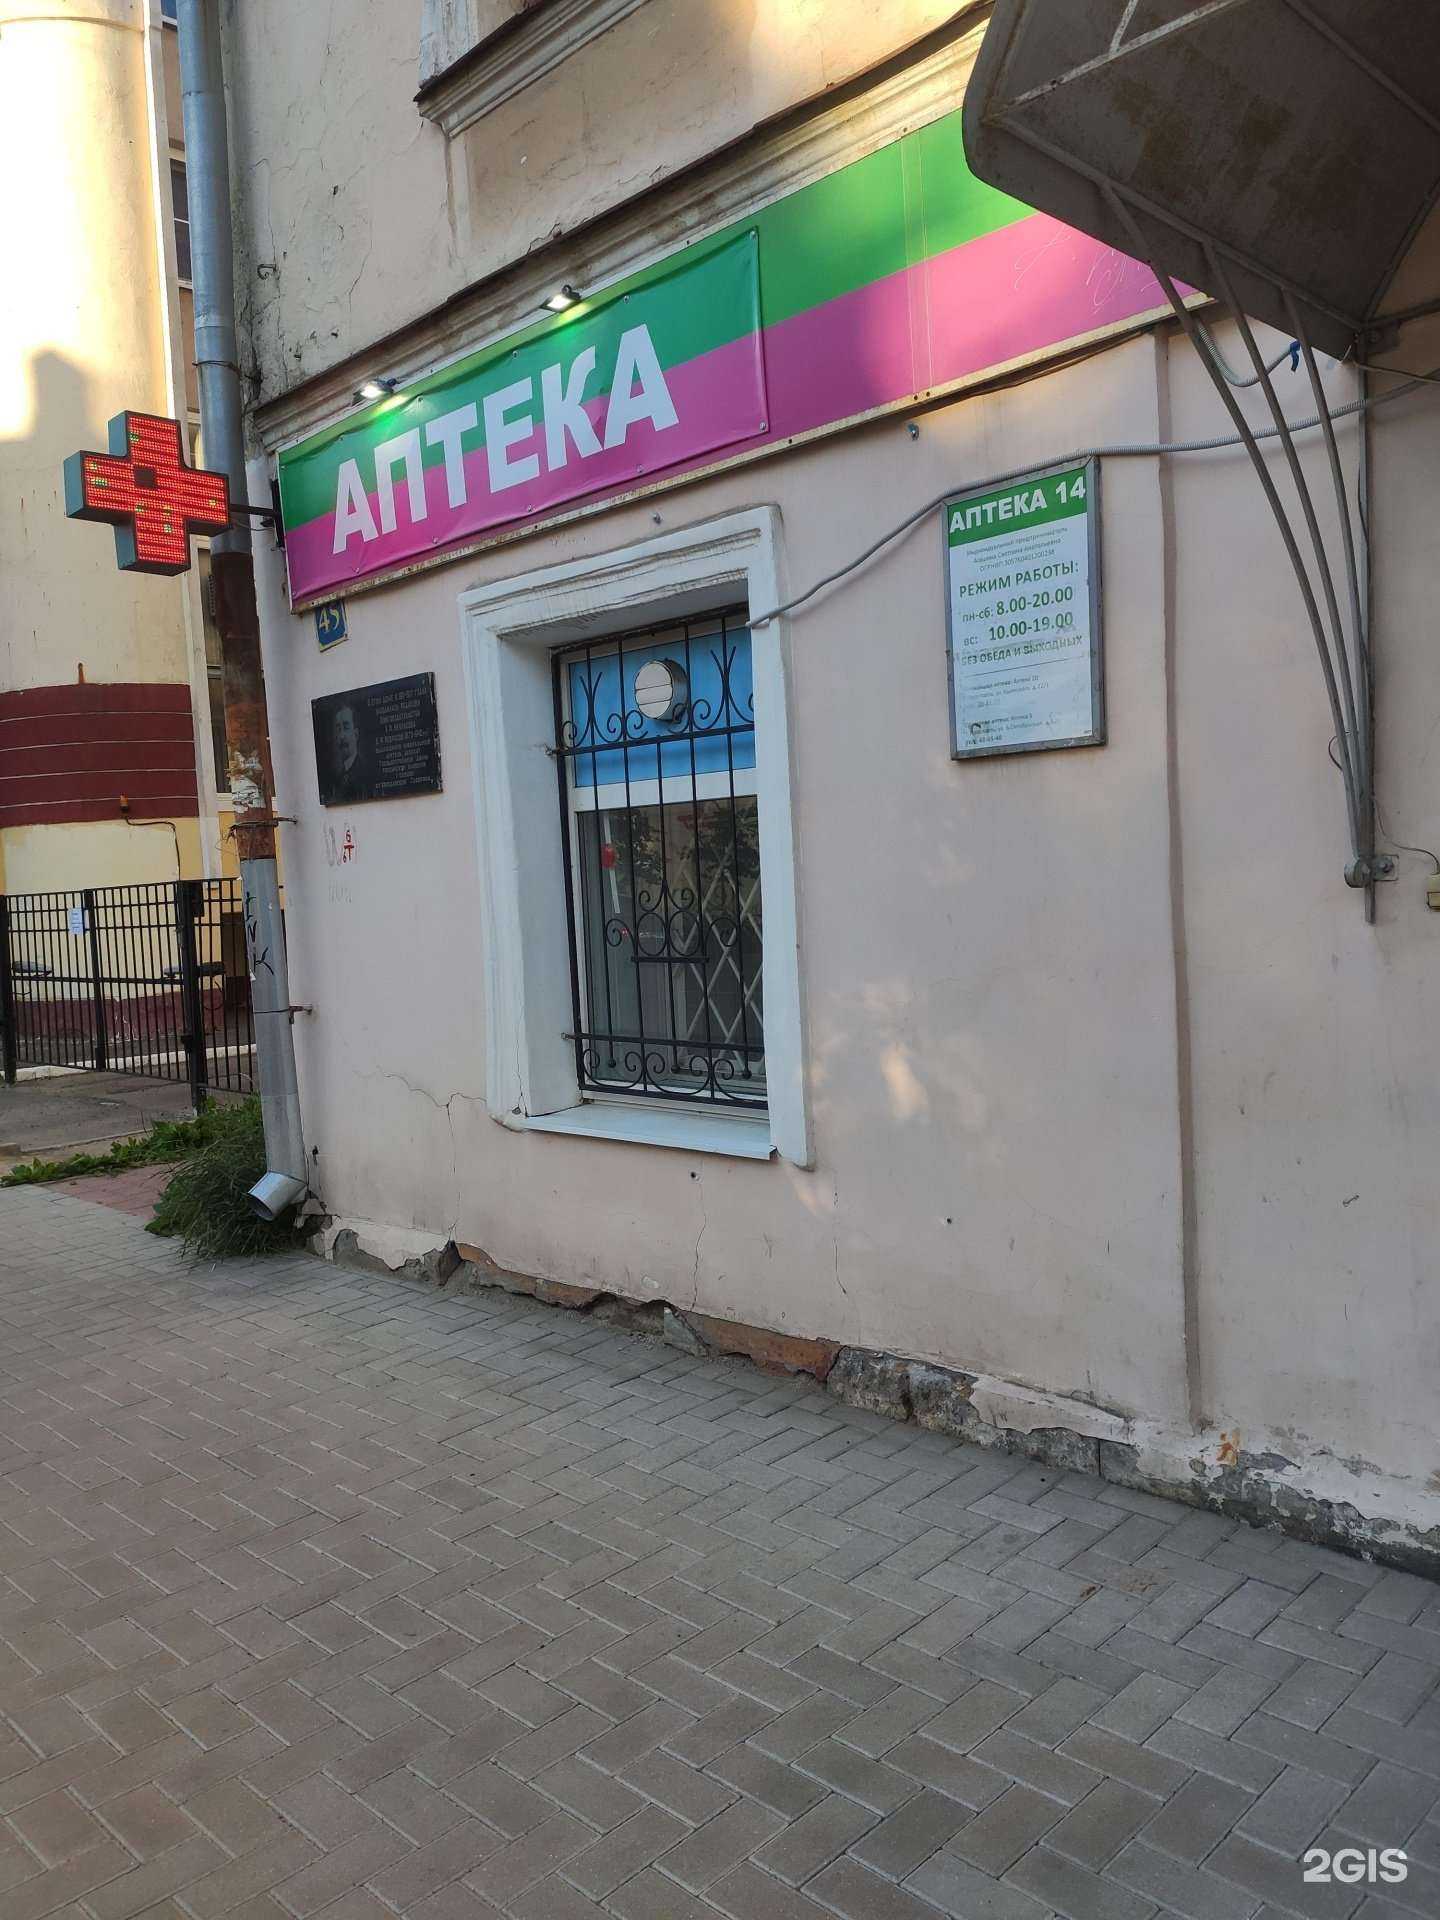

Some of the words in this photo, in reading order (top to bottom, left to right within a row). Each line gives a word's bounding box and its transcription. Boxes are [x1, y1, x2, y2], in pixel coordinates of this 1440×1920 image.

[332, 323, 680, 554] АПТЕКА
[950, 488, 1047, 533] АПТЕКА
[1056, 476, 1085, 504] 14
[960, 576, 1011, 598] РЕЖИМ
[1016, 560, 1079, 584] РАБОТЫ:
[996, 586, 1073, 615] 8.00-20.00
[988, 612, 1073, 641] 10.00-19.00
[979, 650, 1011, 663] ОБЕДА
[1013, 647, 1022, 658] И
